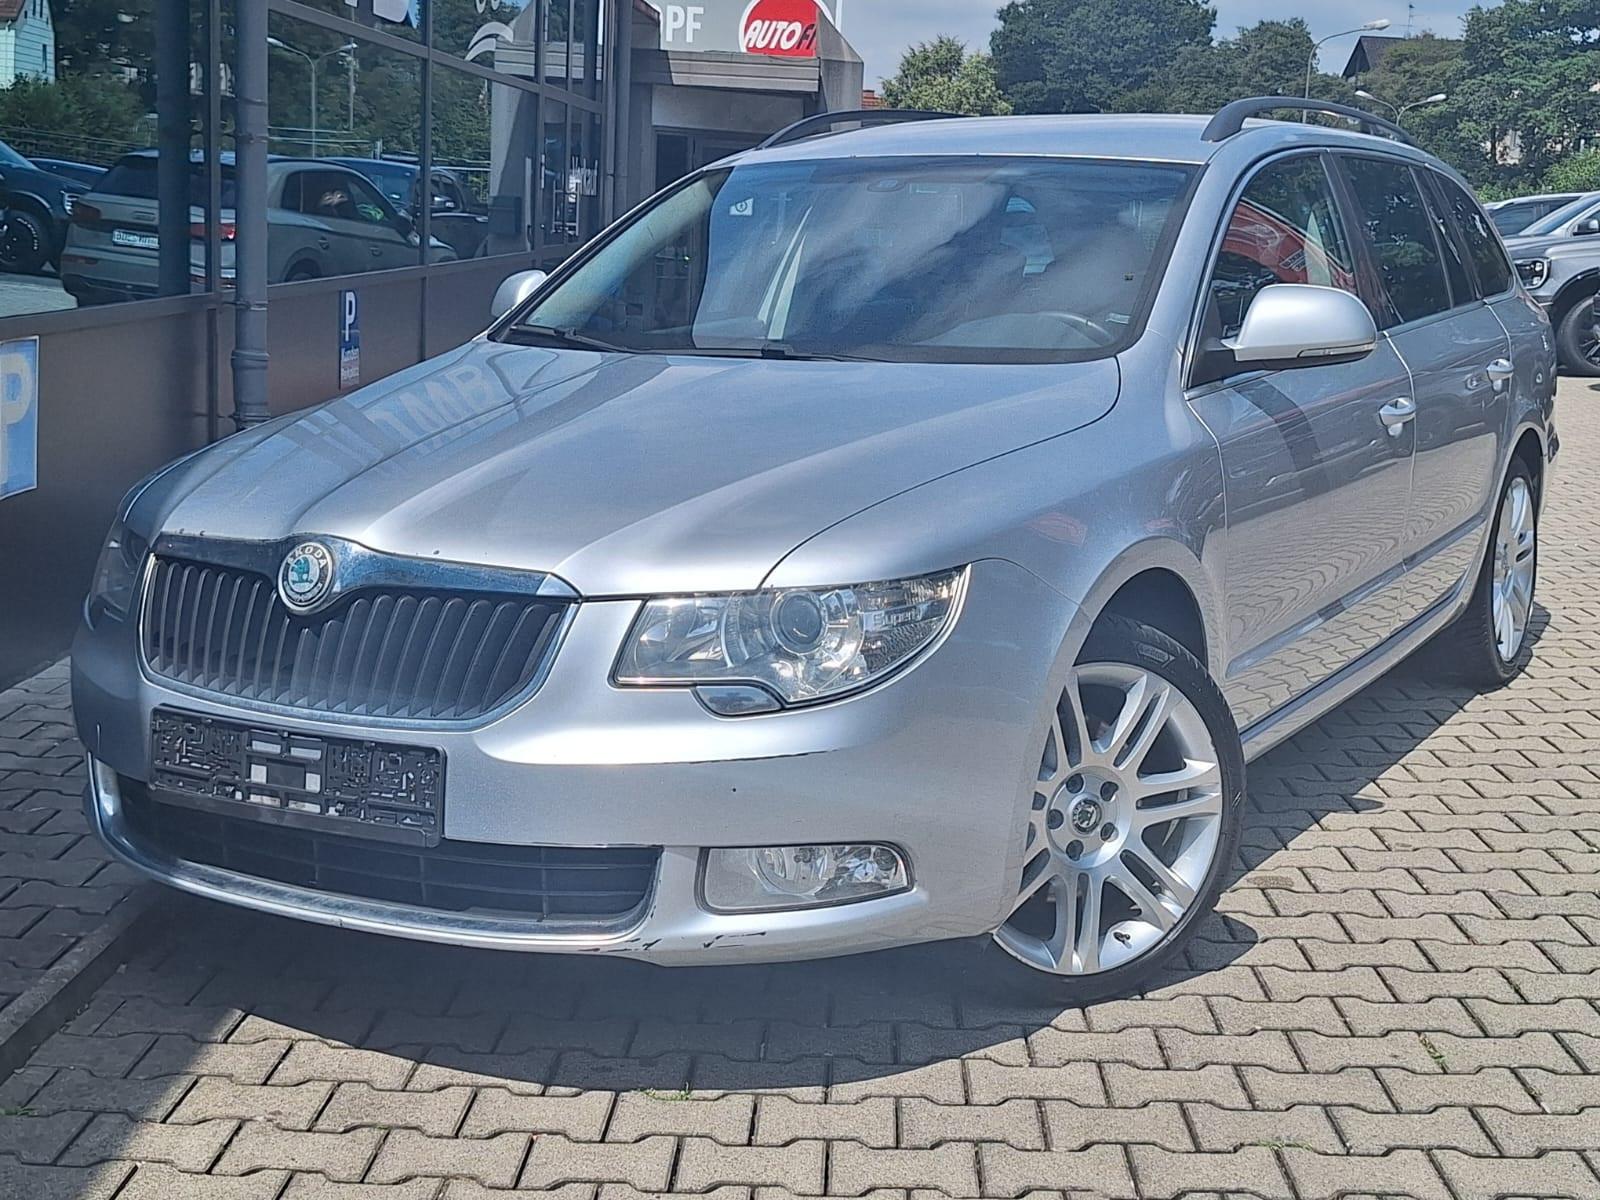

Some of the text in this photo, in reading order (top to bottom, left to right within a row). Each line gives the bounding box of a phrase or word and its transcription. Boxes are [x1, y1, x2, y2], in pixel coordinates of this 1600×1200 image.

[655, 3, 704, 43] PF
[345, 291, 356, 342] P
[0, 353, 32, 485] P
